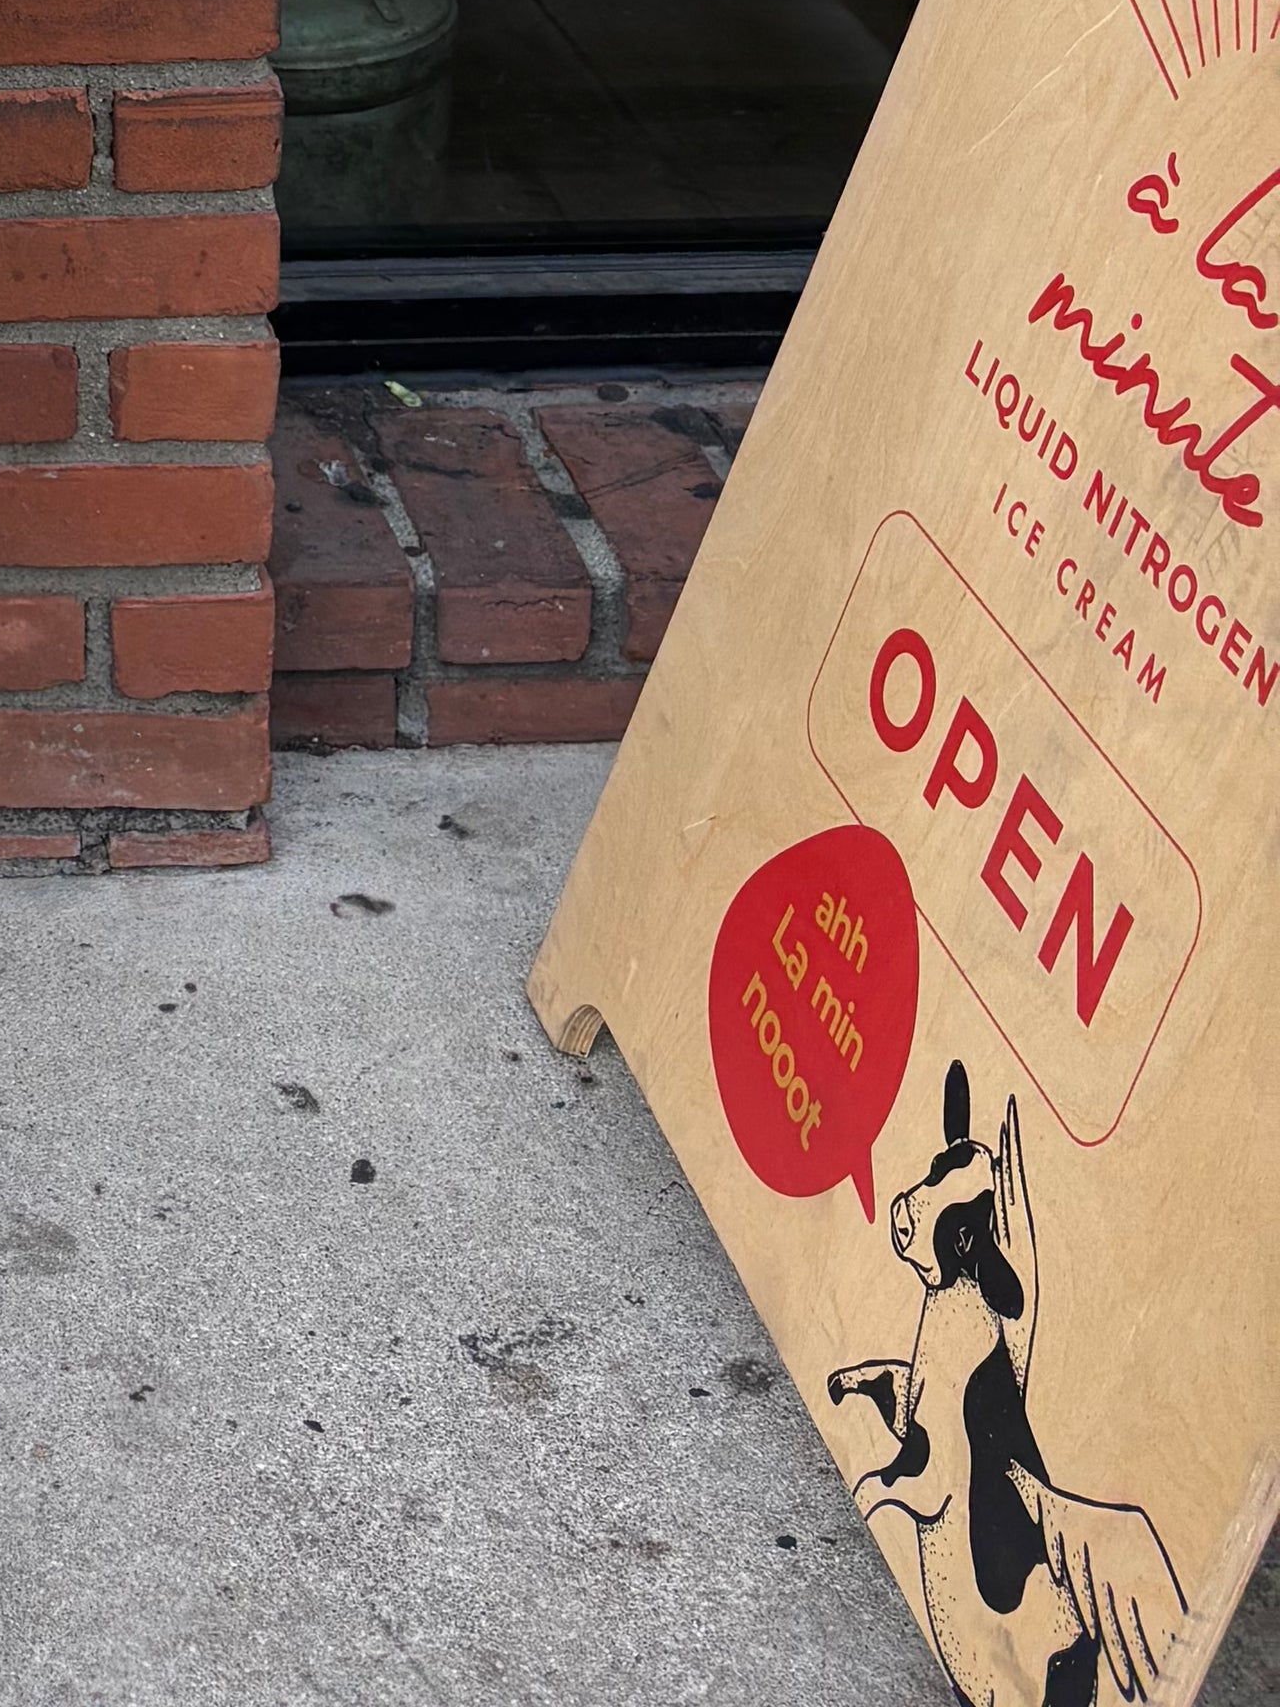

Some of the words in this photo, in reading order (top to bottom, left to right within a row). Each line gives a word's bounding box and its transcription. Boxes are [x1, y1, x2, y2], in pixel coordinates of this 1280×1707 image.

[1028, 271, 1280, 529] minute
[963, 339, 1080, 482] LIQUID
[1082, 468, 1280, 708] NITROGEN
[993, 482, 1045, 559] ICE
[1054, 556, 1169, 705] CREAM
[812, 891, 870, 975] ahh
[868, 627, 1136, 1028] OPEN
[740, 971, 826, 1152] nooot
[809, 990, 865, 1073] min
